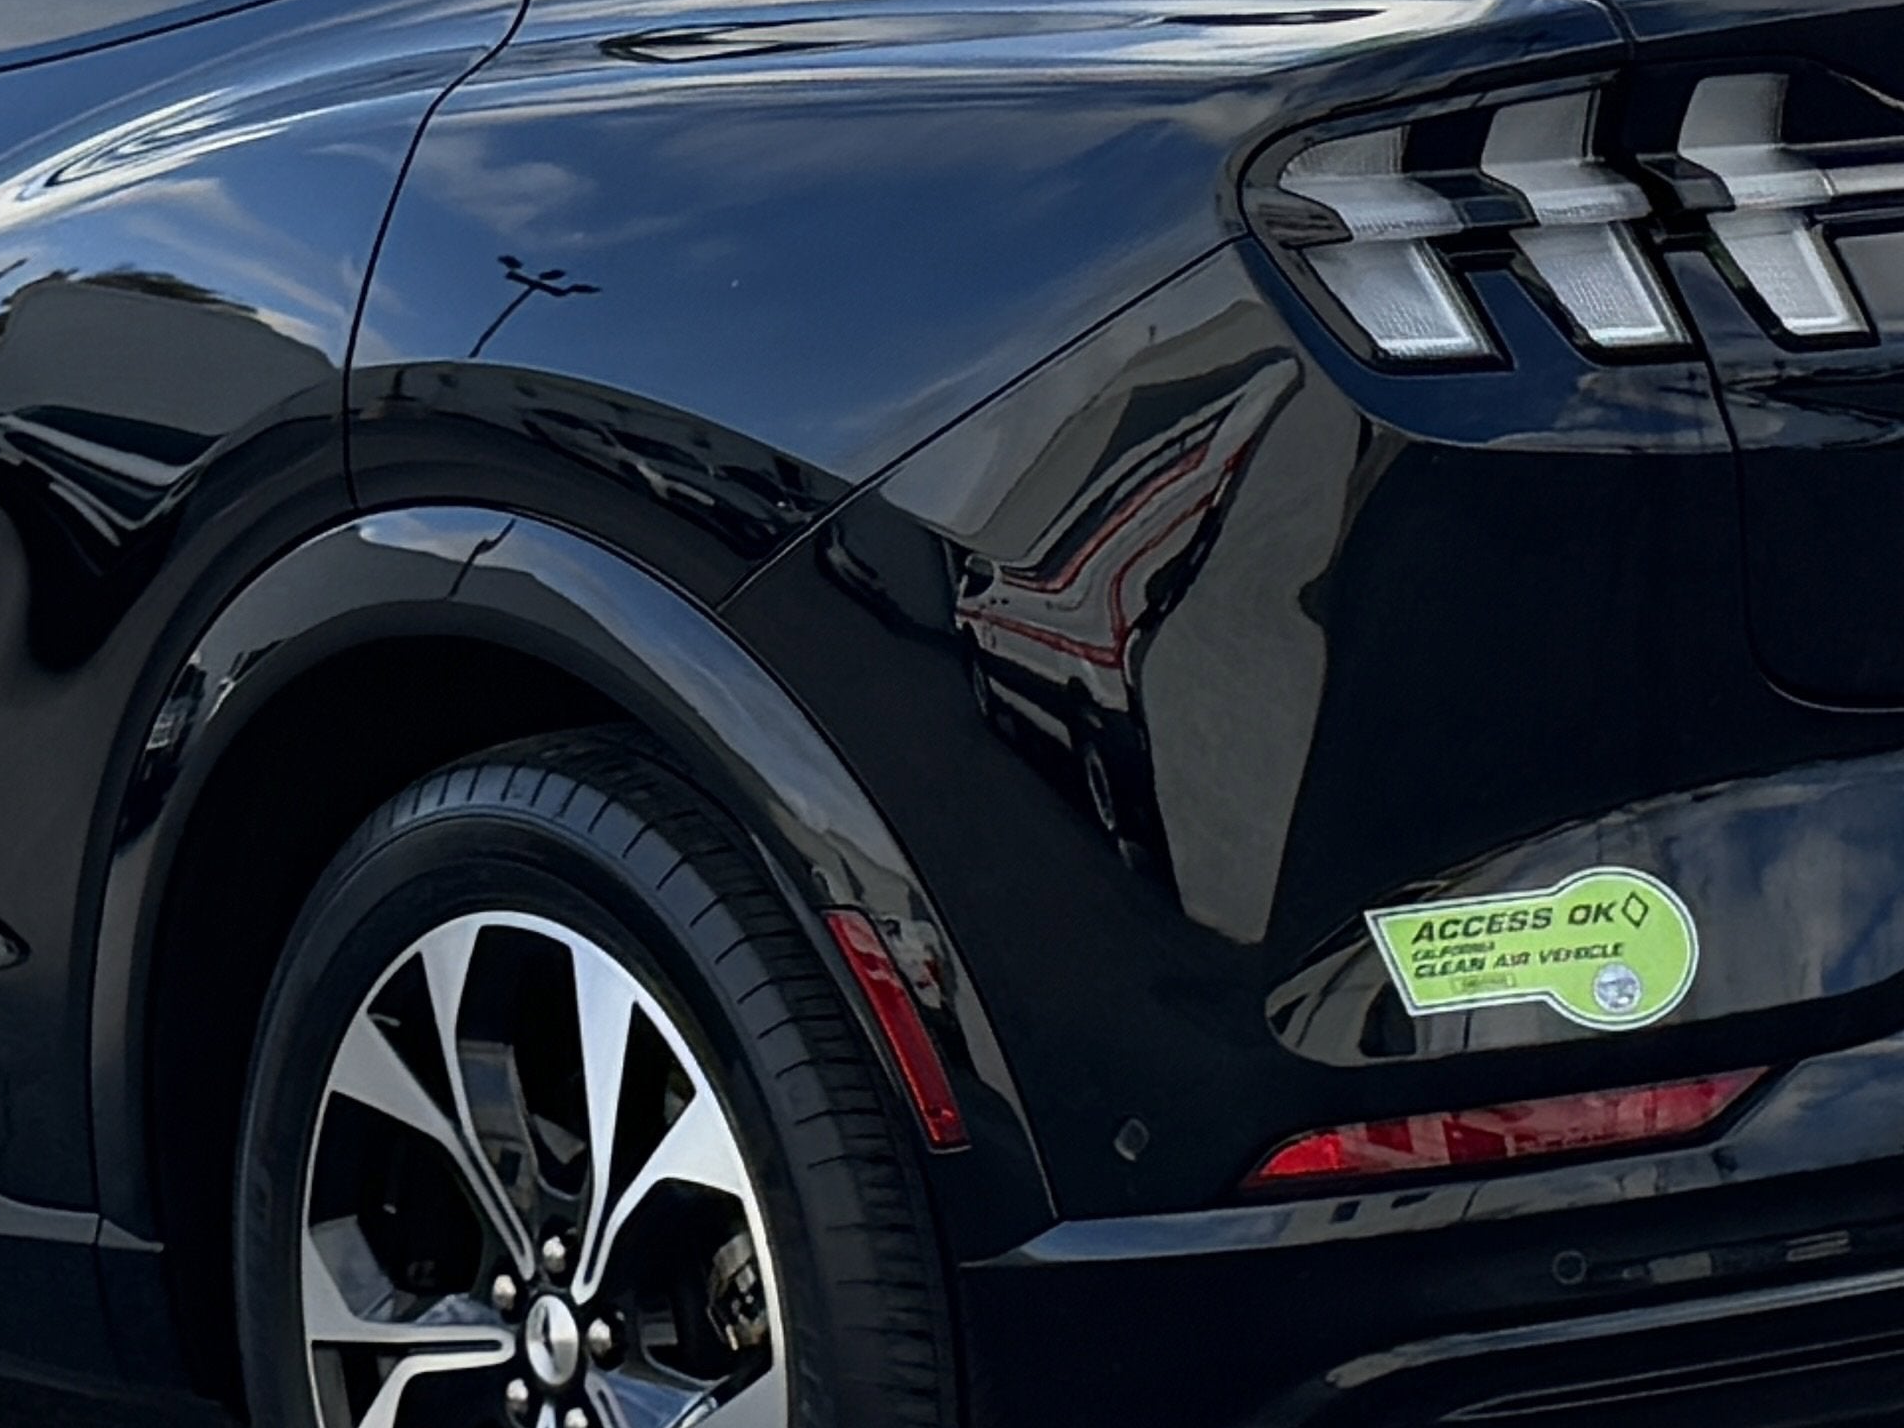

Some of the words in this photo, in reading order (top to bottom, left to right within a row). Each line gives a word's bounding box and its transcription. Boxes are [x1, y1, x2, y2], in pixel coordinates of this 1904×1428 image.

[1411, 907, 1553, 945] ACCESS
[1567, 900, 1617, 926] OK
[1414, 956, 1486, 980] CLEAN
[1493, 950, 1532, 969] AIR
[1538, 941, 1625, 966] VEHICLE
